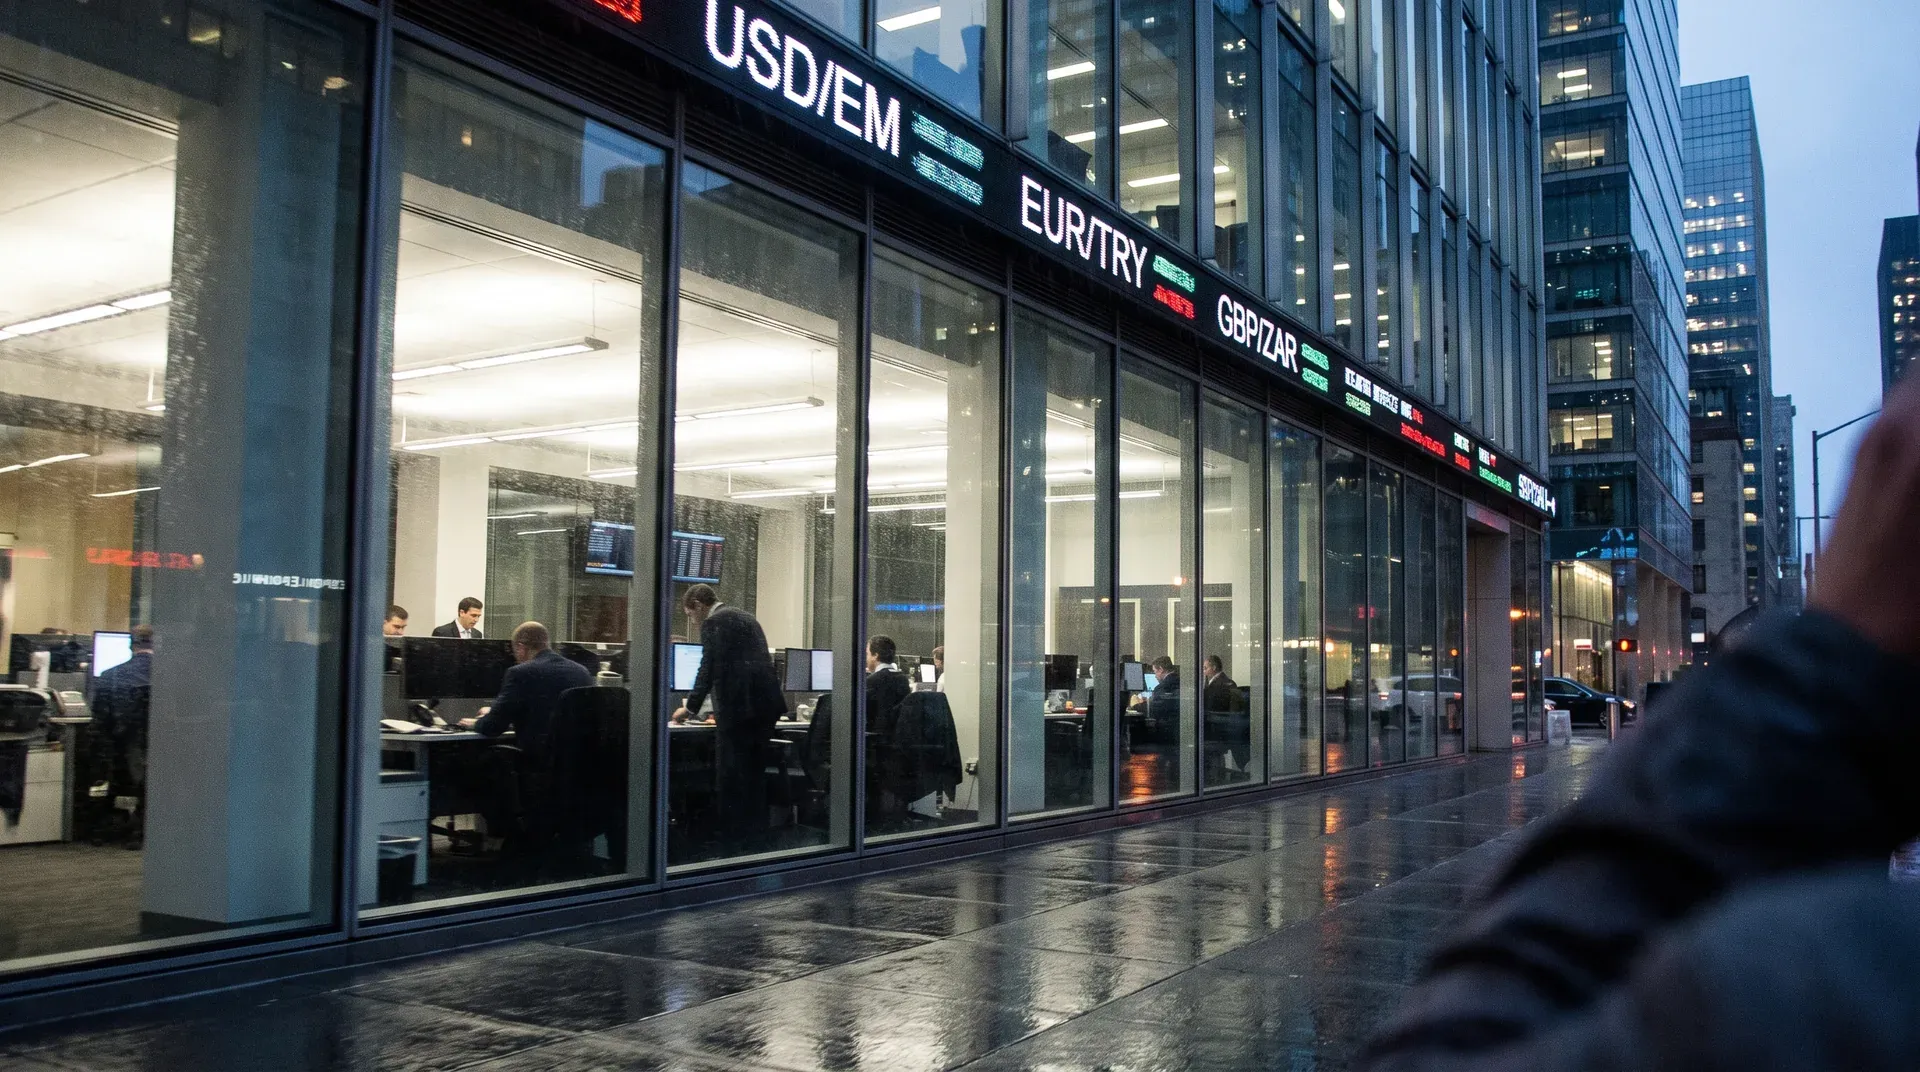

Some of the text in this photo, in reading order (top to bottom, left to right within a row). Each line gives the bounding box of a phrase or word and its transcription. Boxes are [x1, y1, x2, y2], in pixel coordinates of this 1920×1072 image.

[704, 0, 901, 157] USD/EM
[1021, 175, 1148, 289] EUR/TRY
[1217, 294, 1299, 373] GBP/ZAR
